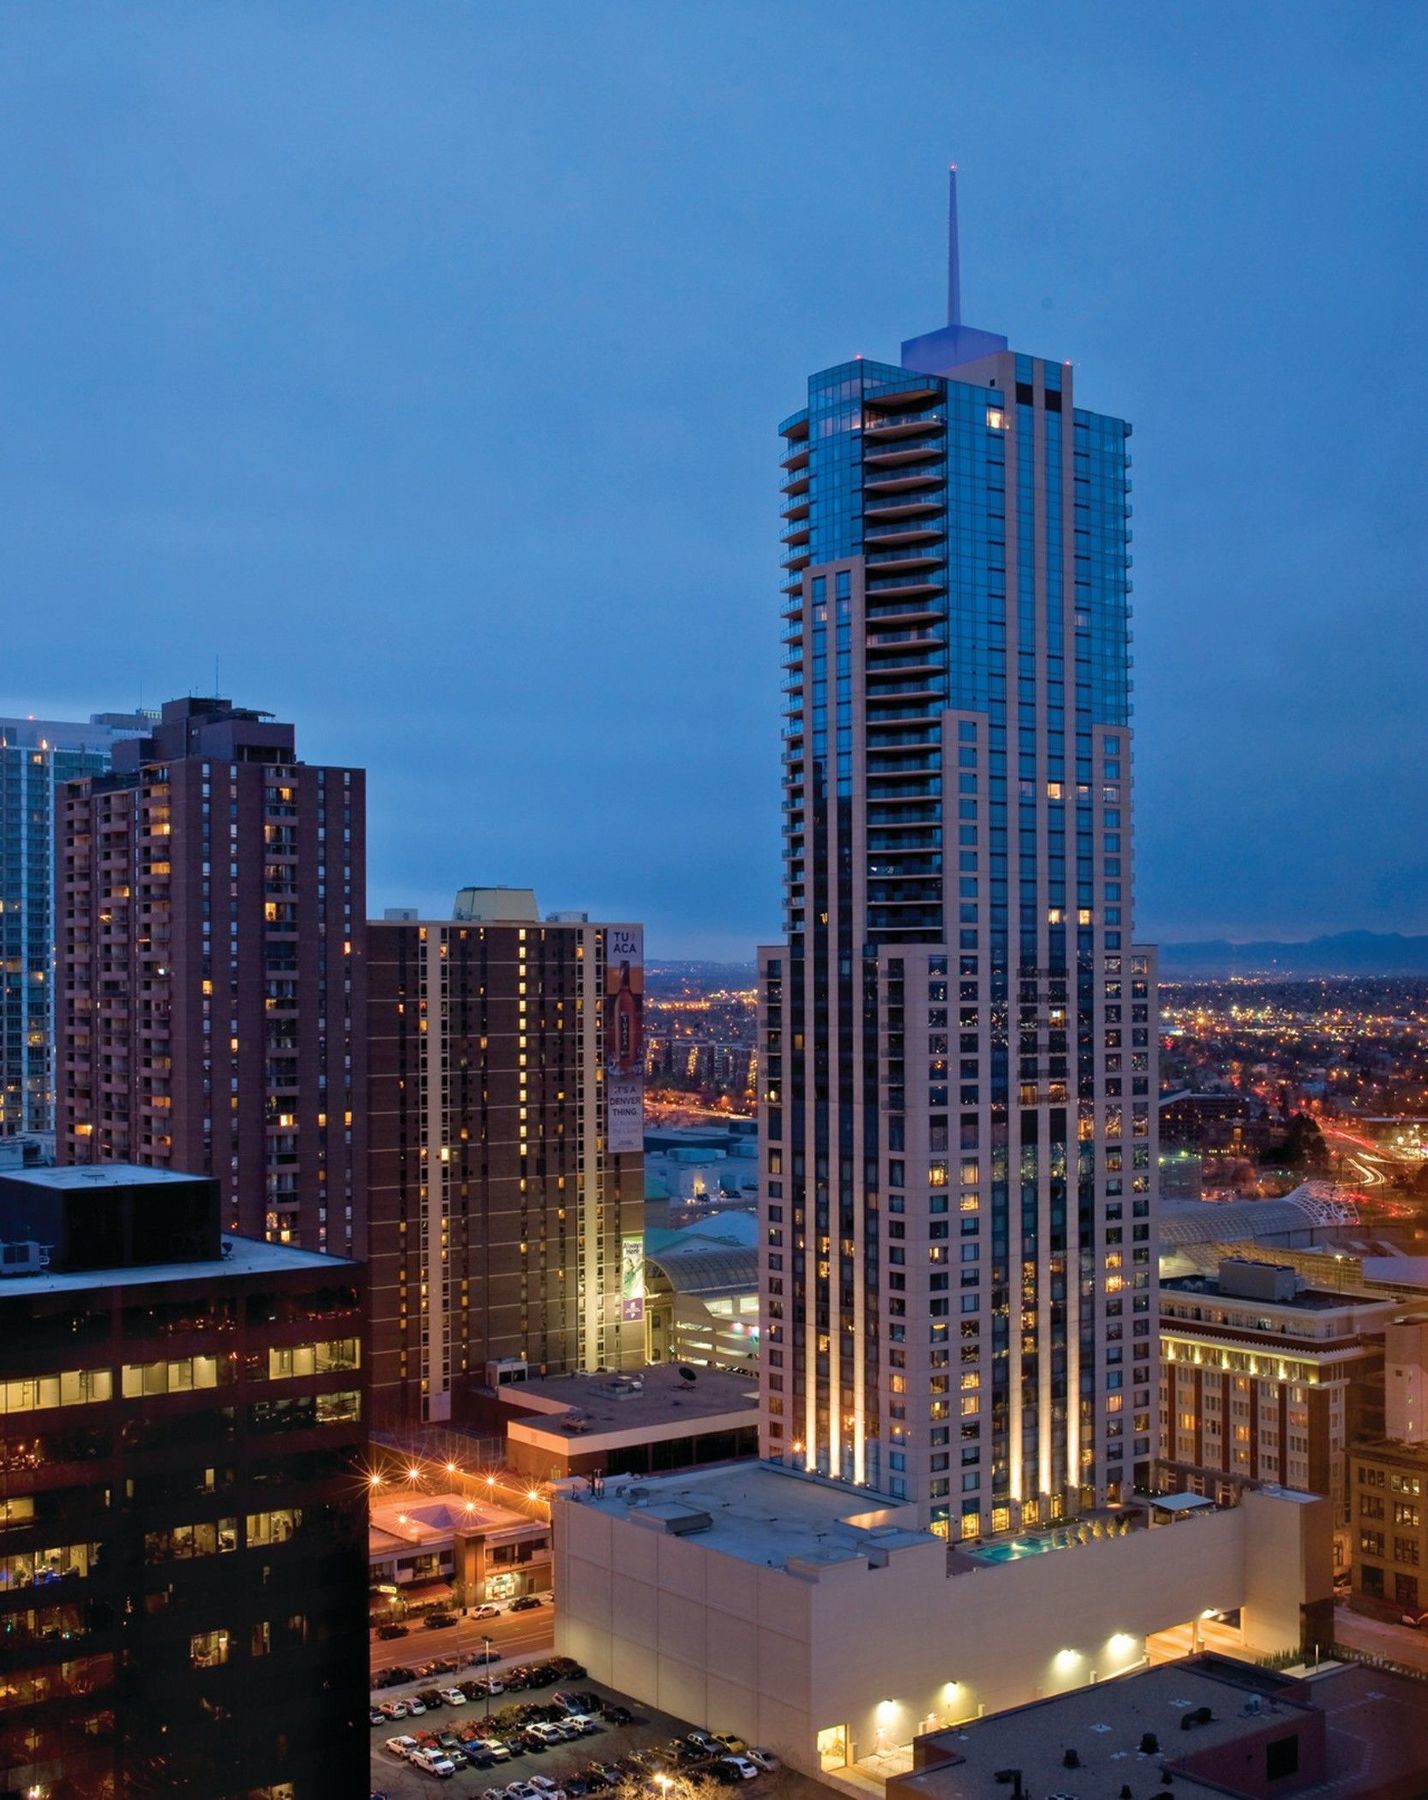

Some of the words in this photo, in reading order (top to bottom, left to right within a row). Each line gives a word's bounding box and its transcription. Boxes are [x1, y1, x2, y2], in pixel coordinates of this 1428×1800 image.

[613, 932, 629, 942] TU
[613, 943, 637, 953] ACA
[610, 1097, 641, 1105] DENVER
